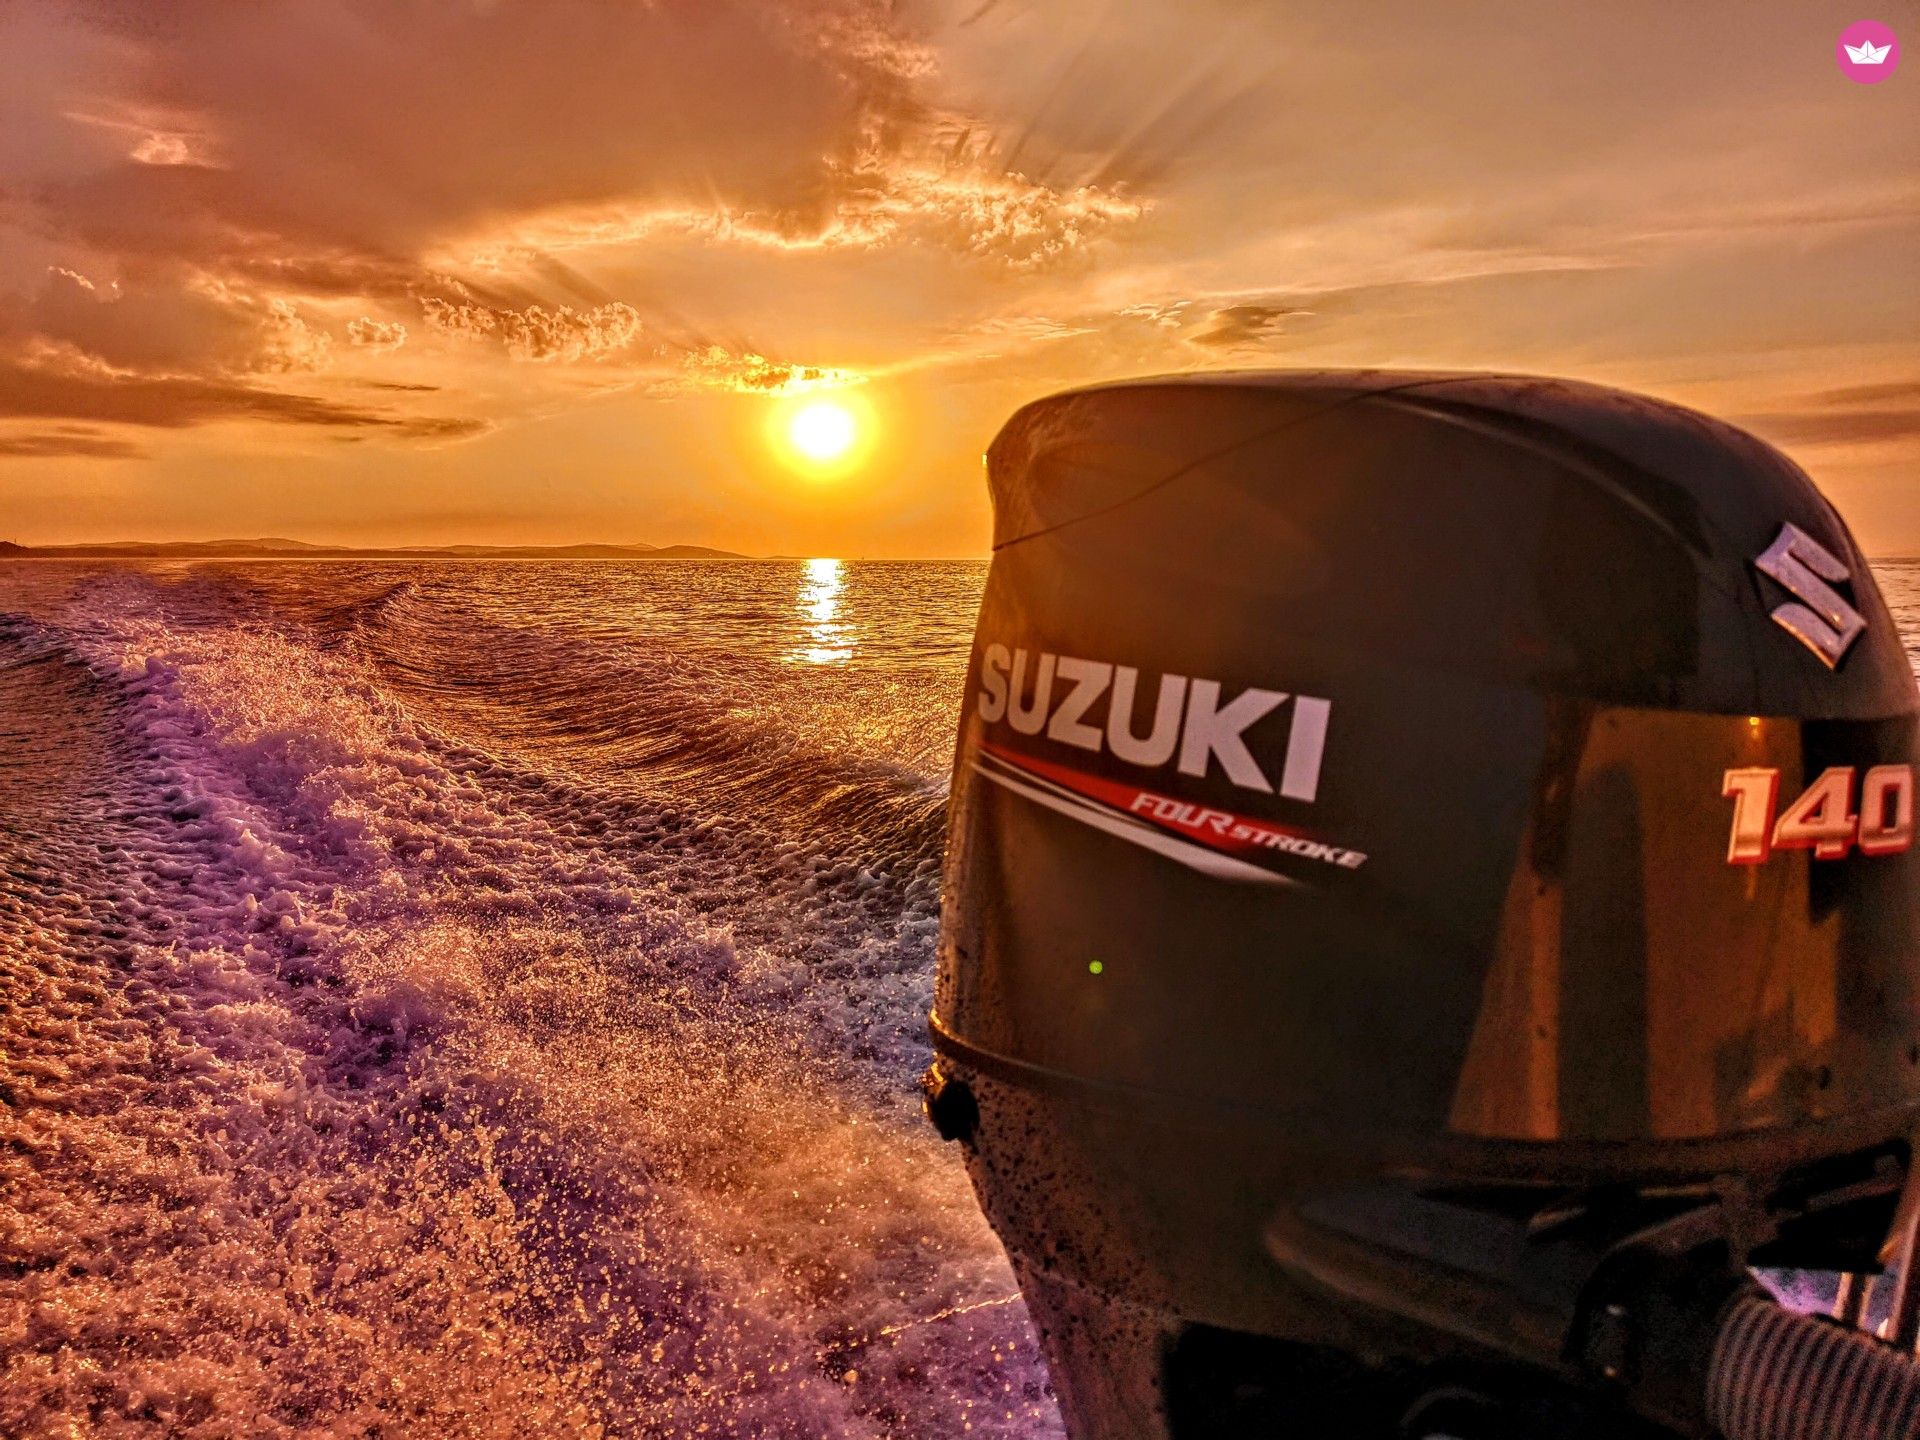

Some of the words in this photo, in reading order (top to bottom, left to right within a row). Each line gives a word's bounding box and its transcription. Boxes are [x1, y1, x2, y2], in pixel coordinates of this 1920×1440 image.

[978, 643, 1332, 803] SUZUKI
[1130, 793, 1234, 835] FOUR
[1232, 824, 1367, 869] STROKE
[1721, 764, 1913, 865] 140
